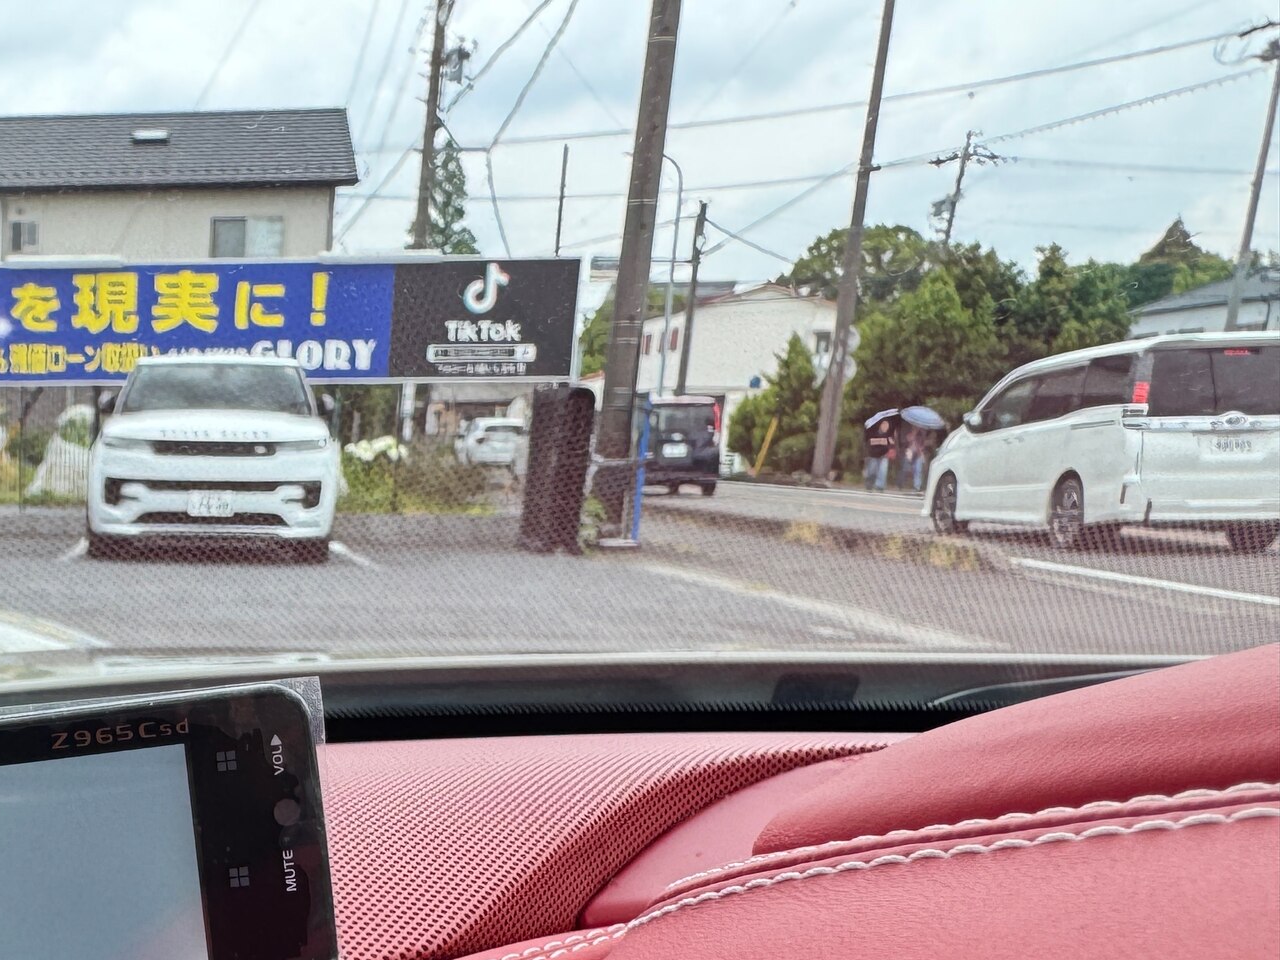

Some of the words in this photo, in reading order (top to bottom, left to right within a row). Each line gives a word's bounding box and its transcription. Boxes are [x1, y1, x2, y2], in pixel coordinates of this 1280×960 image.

[444, 319, 522, 342] TikTok
[51, 718, 190, 750] Z965Csd
[272, 745, 285, 776] VOL
[283, 849, 298, 893] MUTE
